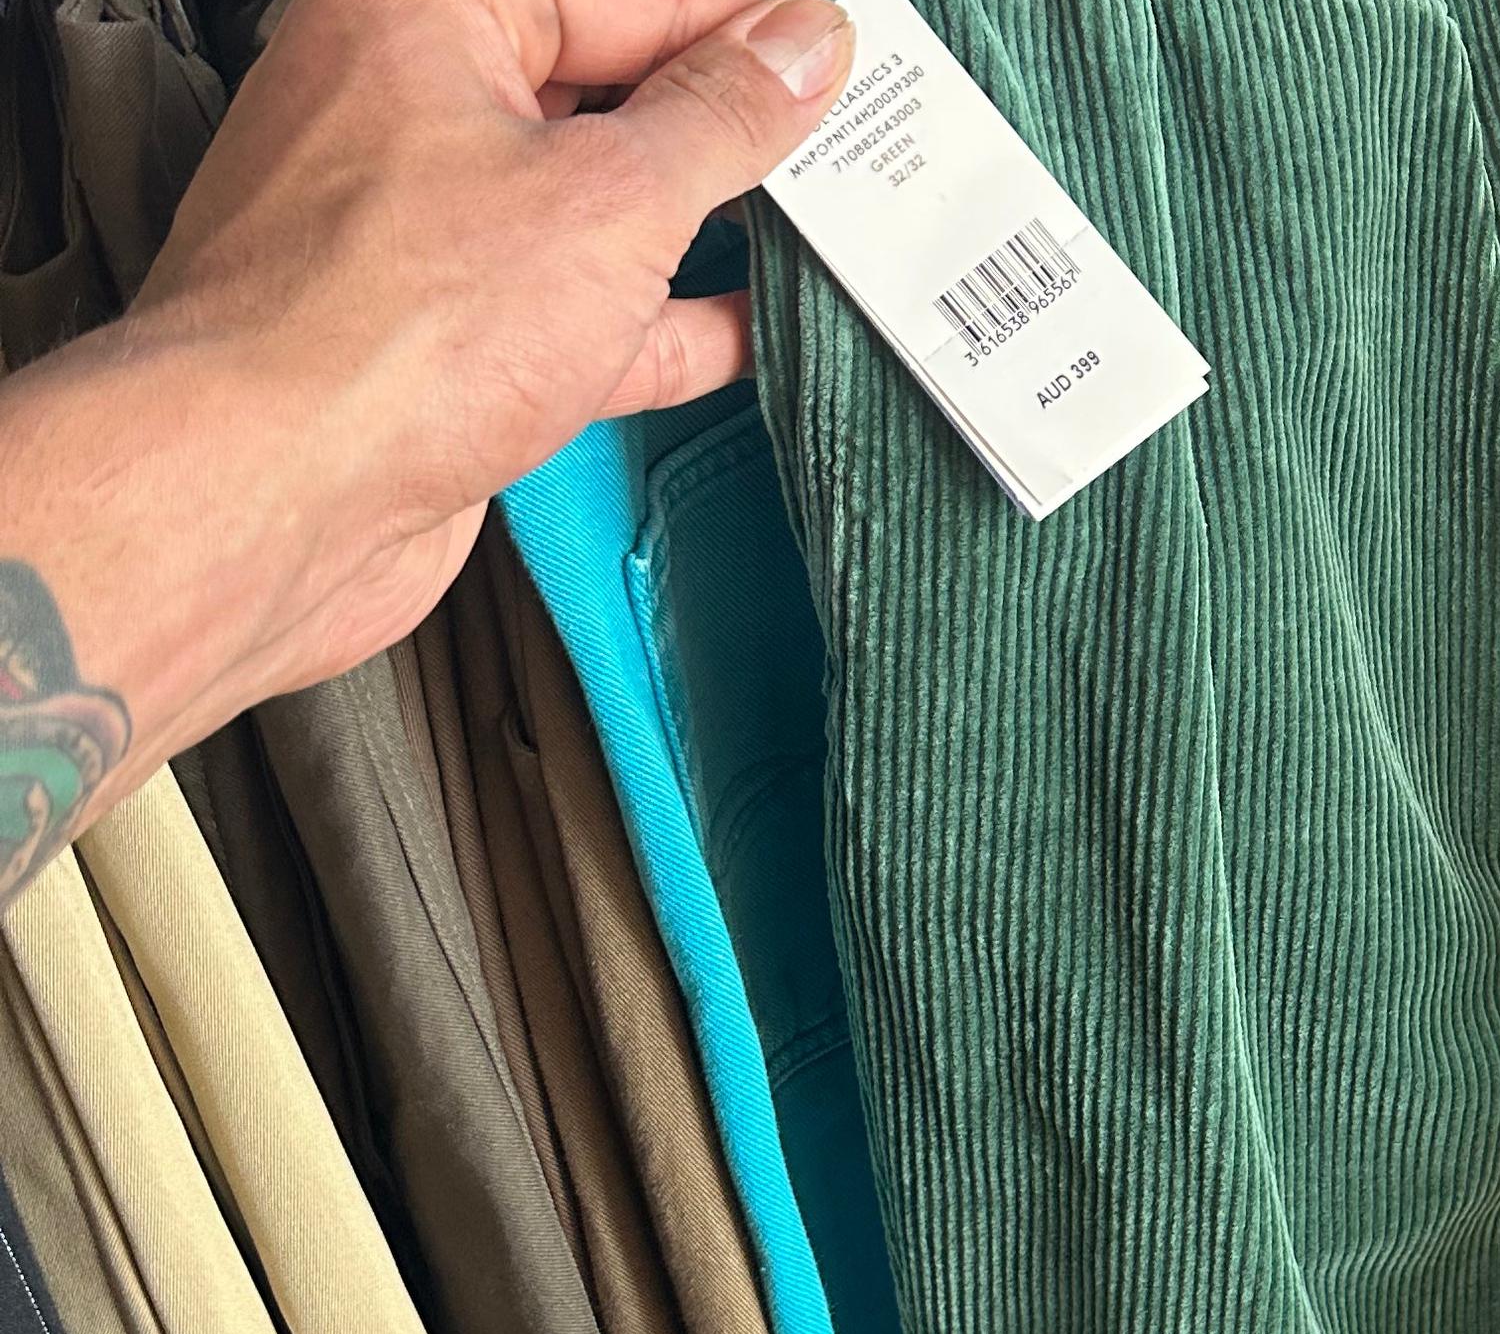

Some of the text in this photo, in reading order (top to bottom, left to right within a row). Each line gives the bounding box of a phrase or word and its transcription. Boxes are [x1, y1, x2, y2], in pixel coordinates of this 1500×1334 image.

[829, 63, 892, 116] CLASSICS
[891, 53, 903, 66] 3
[832, 97, 922, 173] 710882543003
[870, 132, 916, 173] GREEN
[888, 153, 927, 188] 32/32
[1036, 350, 1101, 410] AUD 399
